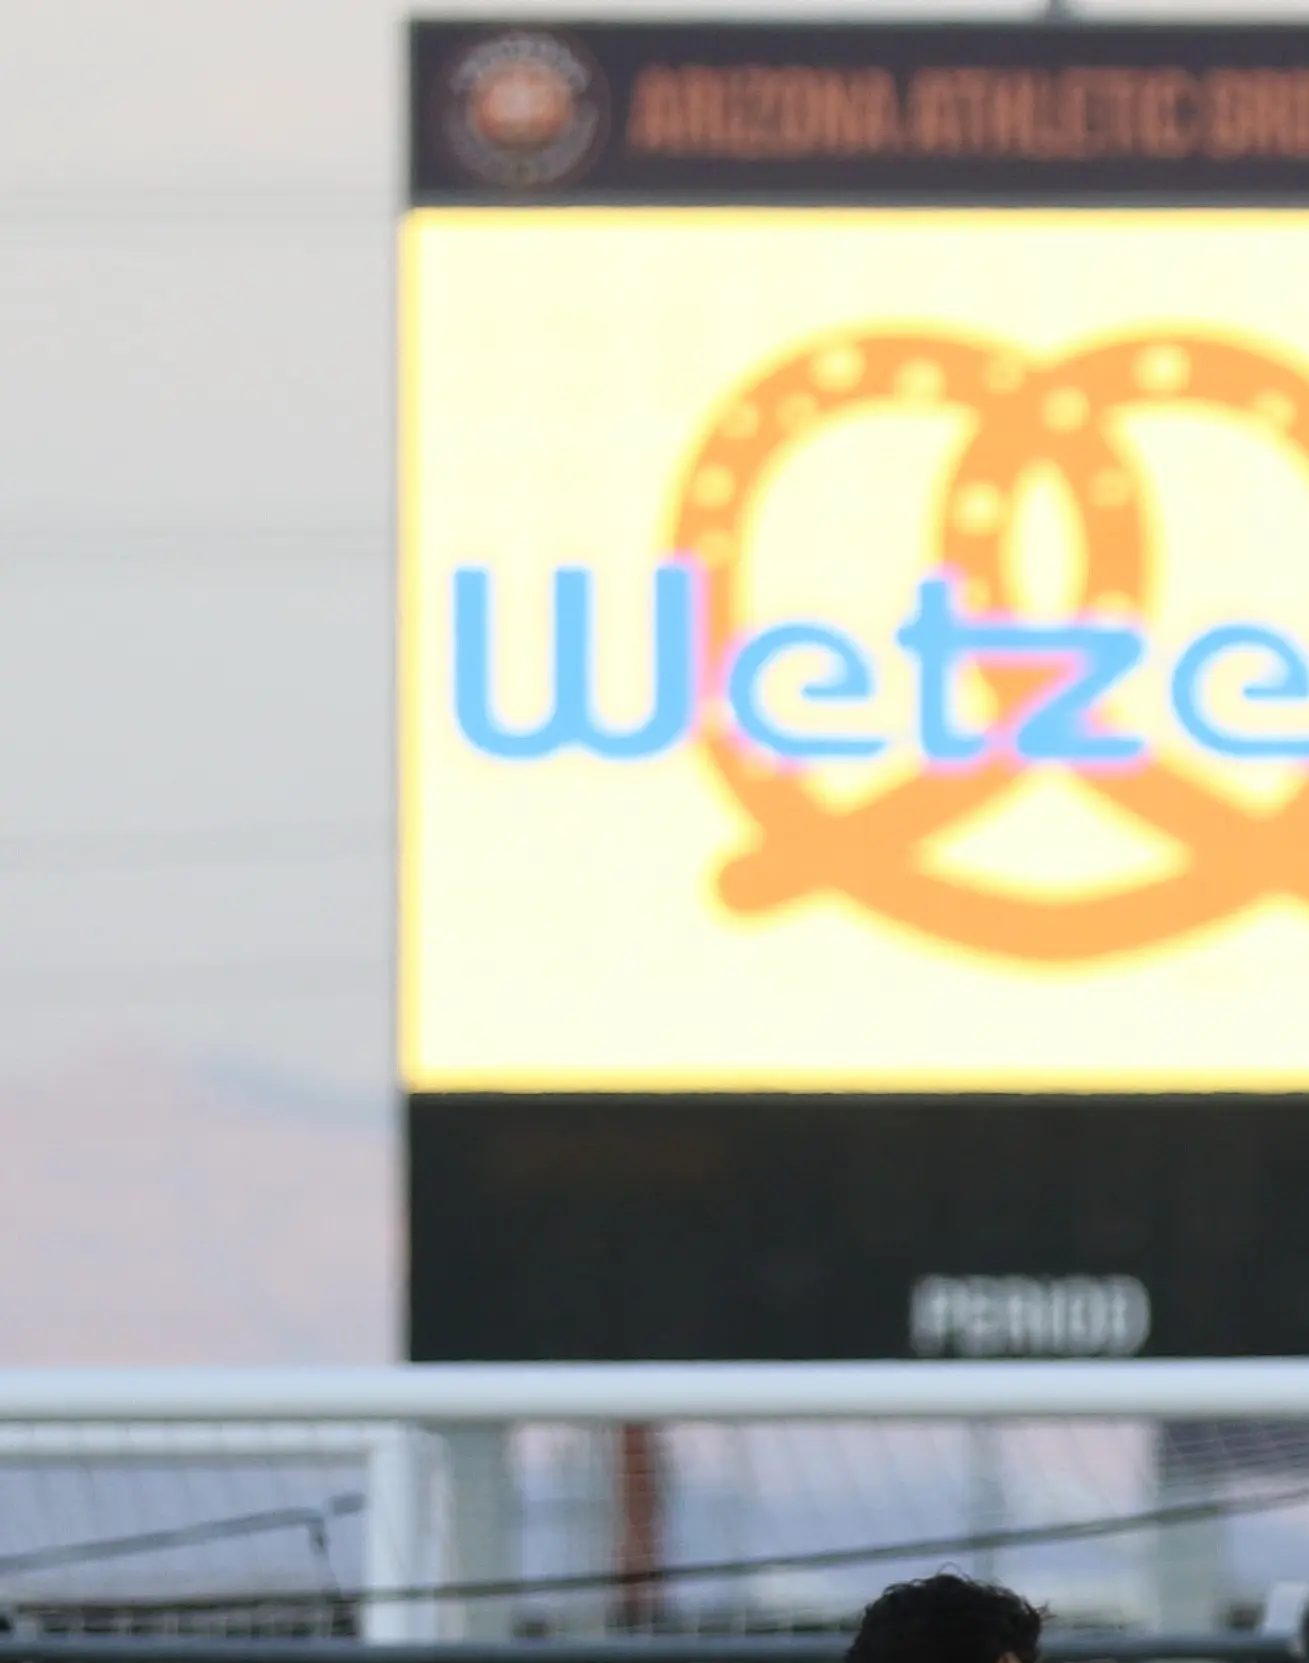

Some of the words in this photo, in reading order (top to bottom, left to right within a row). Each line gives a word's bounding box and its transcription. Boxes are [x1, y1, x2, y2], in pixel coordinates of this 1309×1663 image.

[630, 63, 899, 158] ARIZONA
[905, 63, 1199, 158] ATHLETIC
[910, 1273, 1151, 1357] PERIOD
